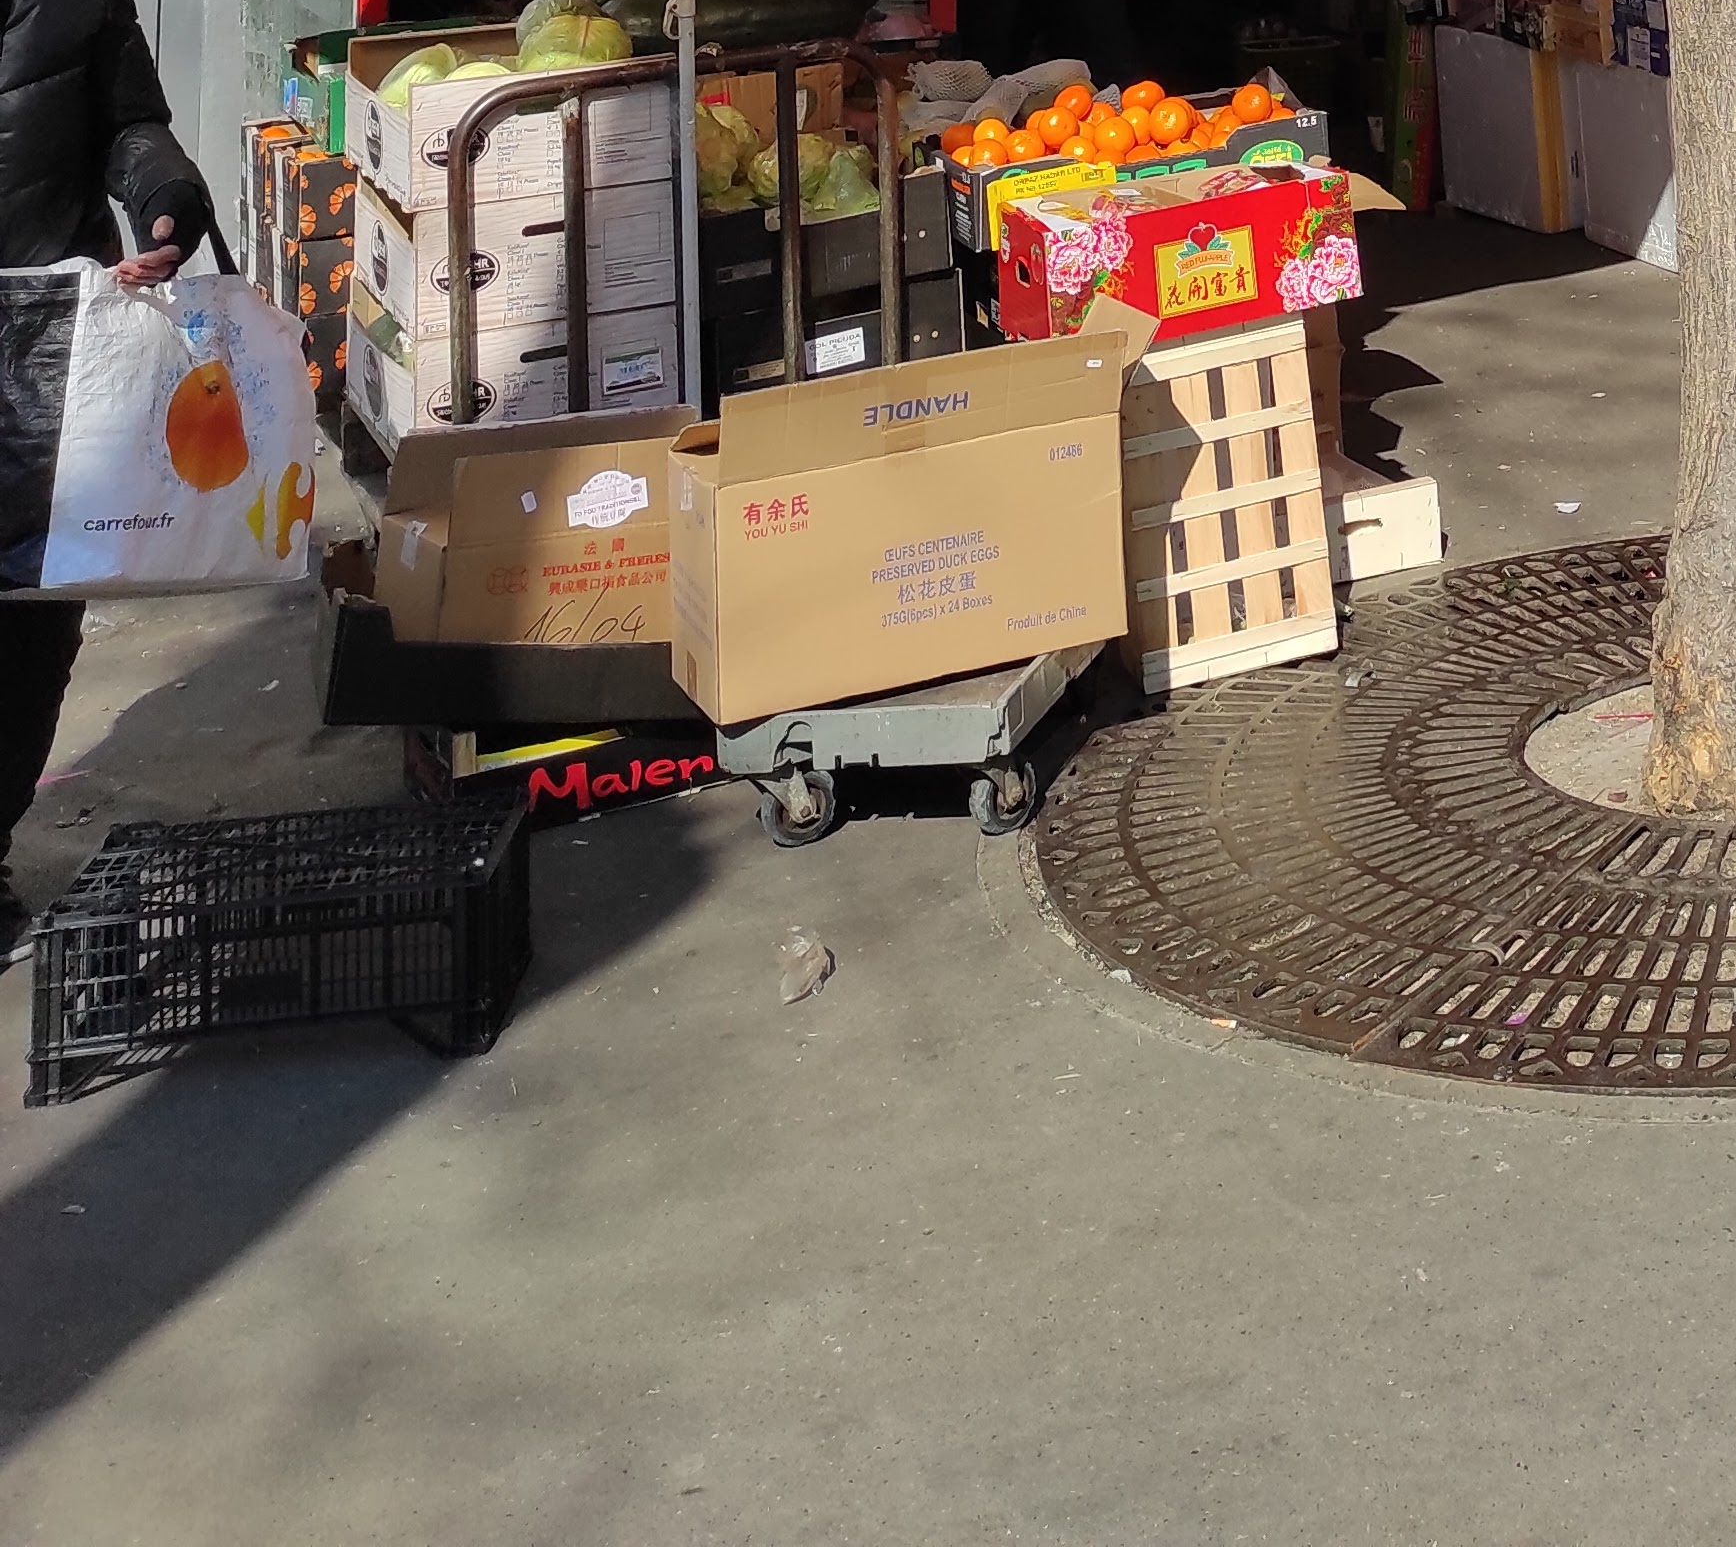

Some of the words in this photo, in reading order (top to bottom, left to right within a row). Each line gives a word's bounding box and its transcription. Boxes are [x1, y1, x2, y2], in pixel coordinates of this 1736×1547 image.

[1296, 115, 1318, 128] 12.5
[862, 390, 970, 427] HANDLE
[83, 511, 175, 532] carrefour.fr
[742, 493, 810, 527] 有余氏
[744, 526, 768, 541] YOU
[771, 523, 788, 536] YU
[789, 519, 809, 533] SHI
[884, 544, 916, 563] ŒUFS
[917, 530, 985, 558] CENTENAIRE
[542, 561, 602, 578] EURASIE
[604, 557, 615, 571] &
[871, 558, 936, 585] PRESERVED
[937, 551, 968, 571] DUCK
[970, 545, 1000, 565] EGGS
[897, 571, 977, 605] 松花皮蛋
[523, 583, 647, 644] 16/04
[947, 600, 961, 613] 24
[962, 593, 993, 611] Boxes
[1006, 614, 1043, 632] Produit
[1044, 610, 1057, 625] de
